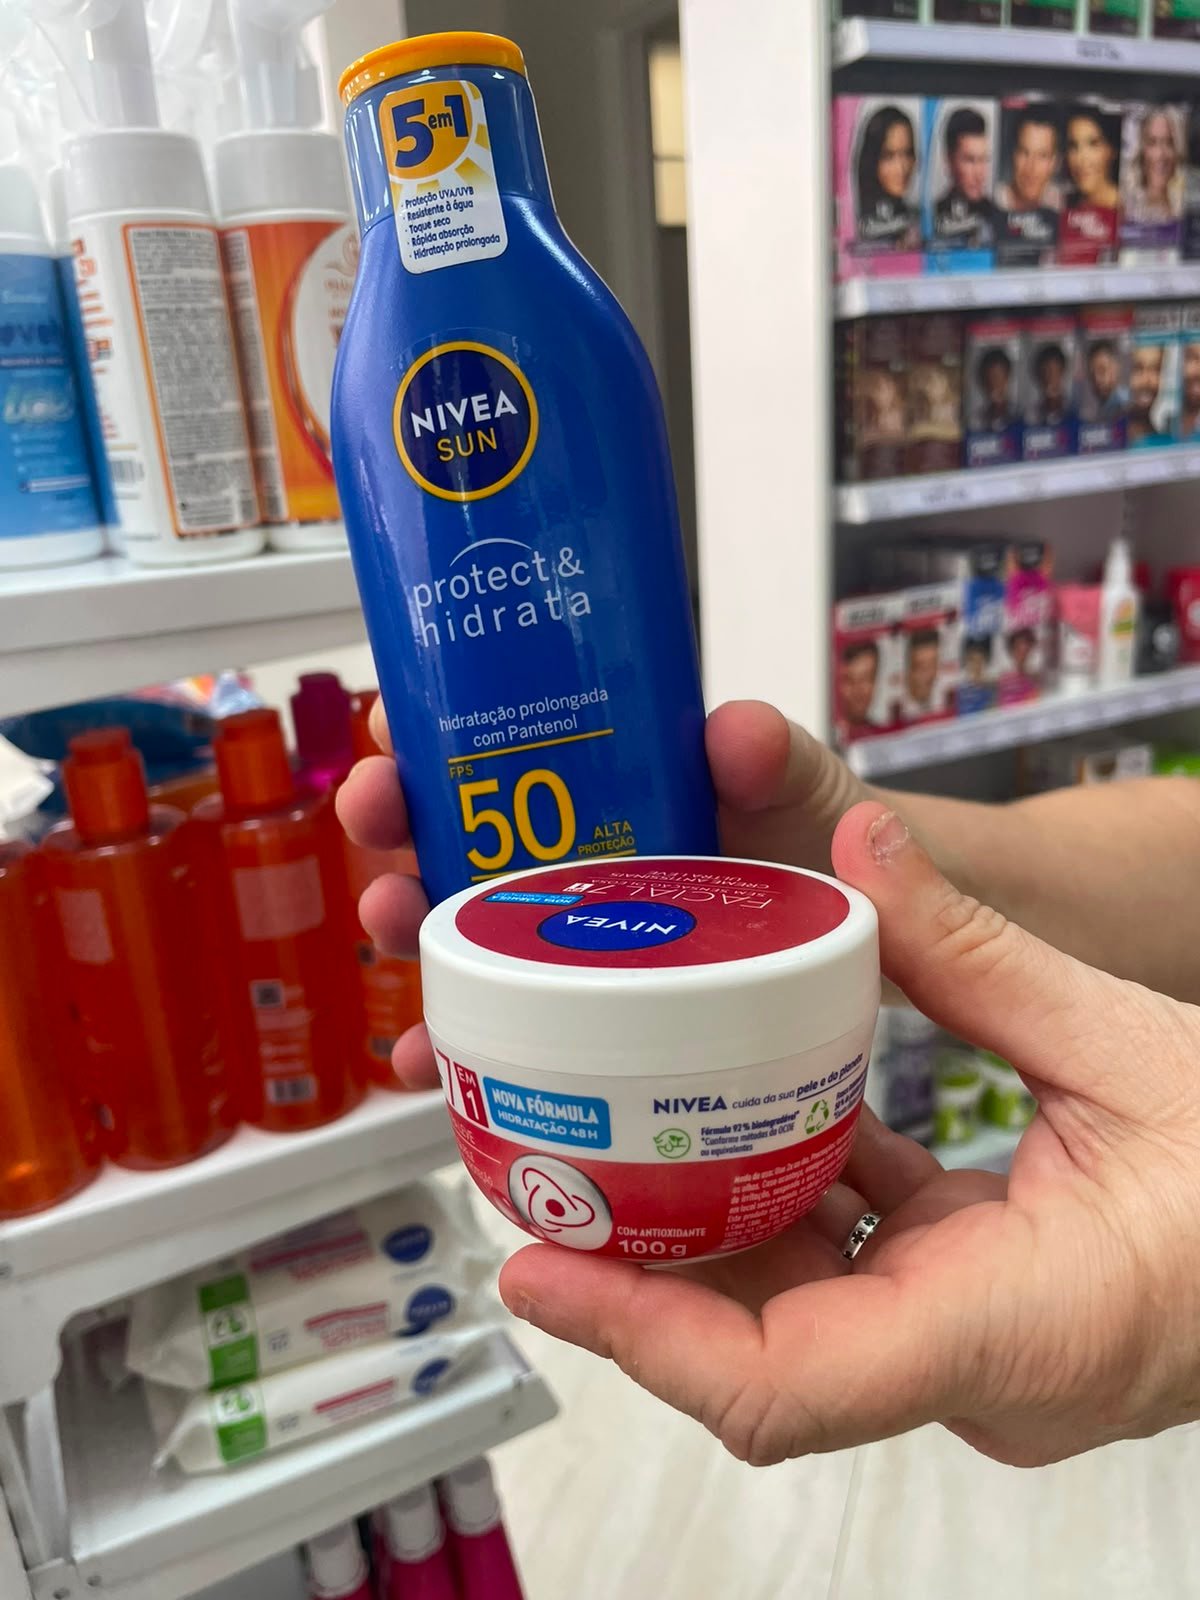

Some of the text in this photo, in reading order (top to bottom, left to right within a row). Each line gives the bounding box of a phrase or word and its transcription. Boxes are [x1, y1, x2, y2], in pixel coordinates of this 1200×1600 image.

[391, 95, 469, 168] 5 em 1
[405, 186, 474, 209] Proteção UVA/UVB
[407, 199, 474, 221] Resistente à água
[409, 217, 451, 234] Toque seco
[411, 224, 474, 247] Rápida absorção
[413, 234, 500, 260] Hidratação prolongada
[410, 389, 519, 438] NIVEA
[437, 427, 498, 461] SUN
[419, 590, 592, 647] hidrata
[439, 687, 609, 732] hidratação prolongada
[473, 714, 578, 747] com Pantenol
[449, 764, 474, 779] FPS
[458, 768, 576, 871] 50
[594, 820, 632, 839] ALTA
[577, 836, 635, 856] PROTEÇÃO
[627, 885, 772, 909] FACIAL
[566, 914, 678, 936] NIVEA
[457, 1066, 477, 1088] EM
[466, 1089, 480, 1120] 1
[653, 1095, 727, 1114] NIVEA
[732, 1096, 760, 1109] cuida
[763, 1091, 776, 1103] da
[778, 1090, 795, 1099] sua
[796, 1080, 818, 1098] pele
[820, 1077, 826, 1086] e
[827, 1071, 839, 1083] do
[491, 1087, 600, 1125] NOVA FÓRMULA
[497, 1109, 567, 1135] HIDRATAÇÃO
[701, 1125, 731, 1136] Fórmula
[617, 1226, 707, 1238] COM ANTIOXIDANTE
[618, 1239, 687, 1257] 100 g
